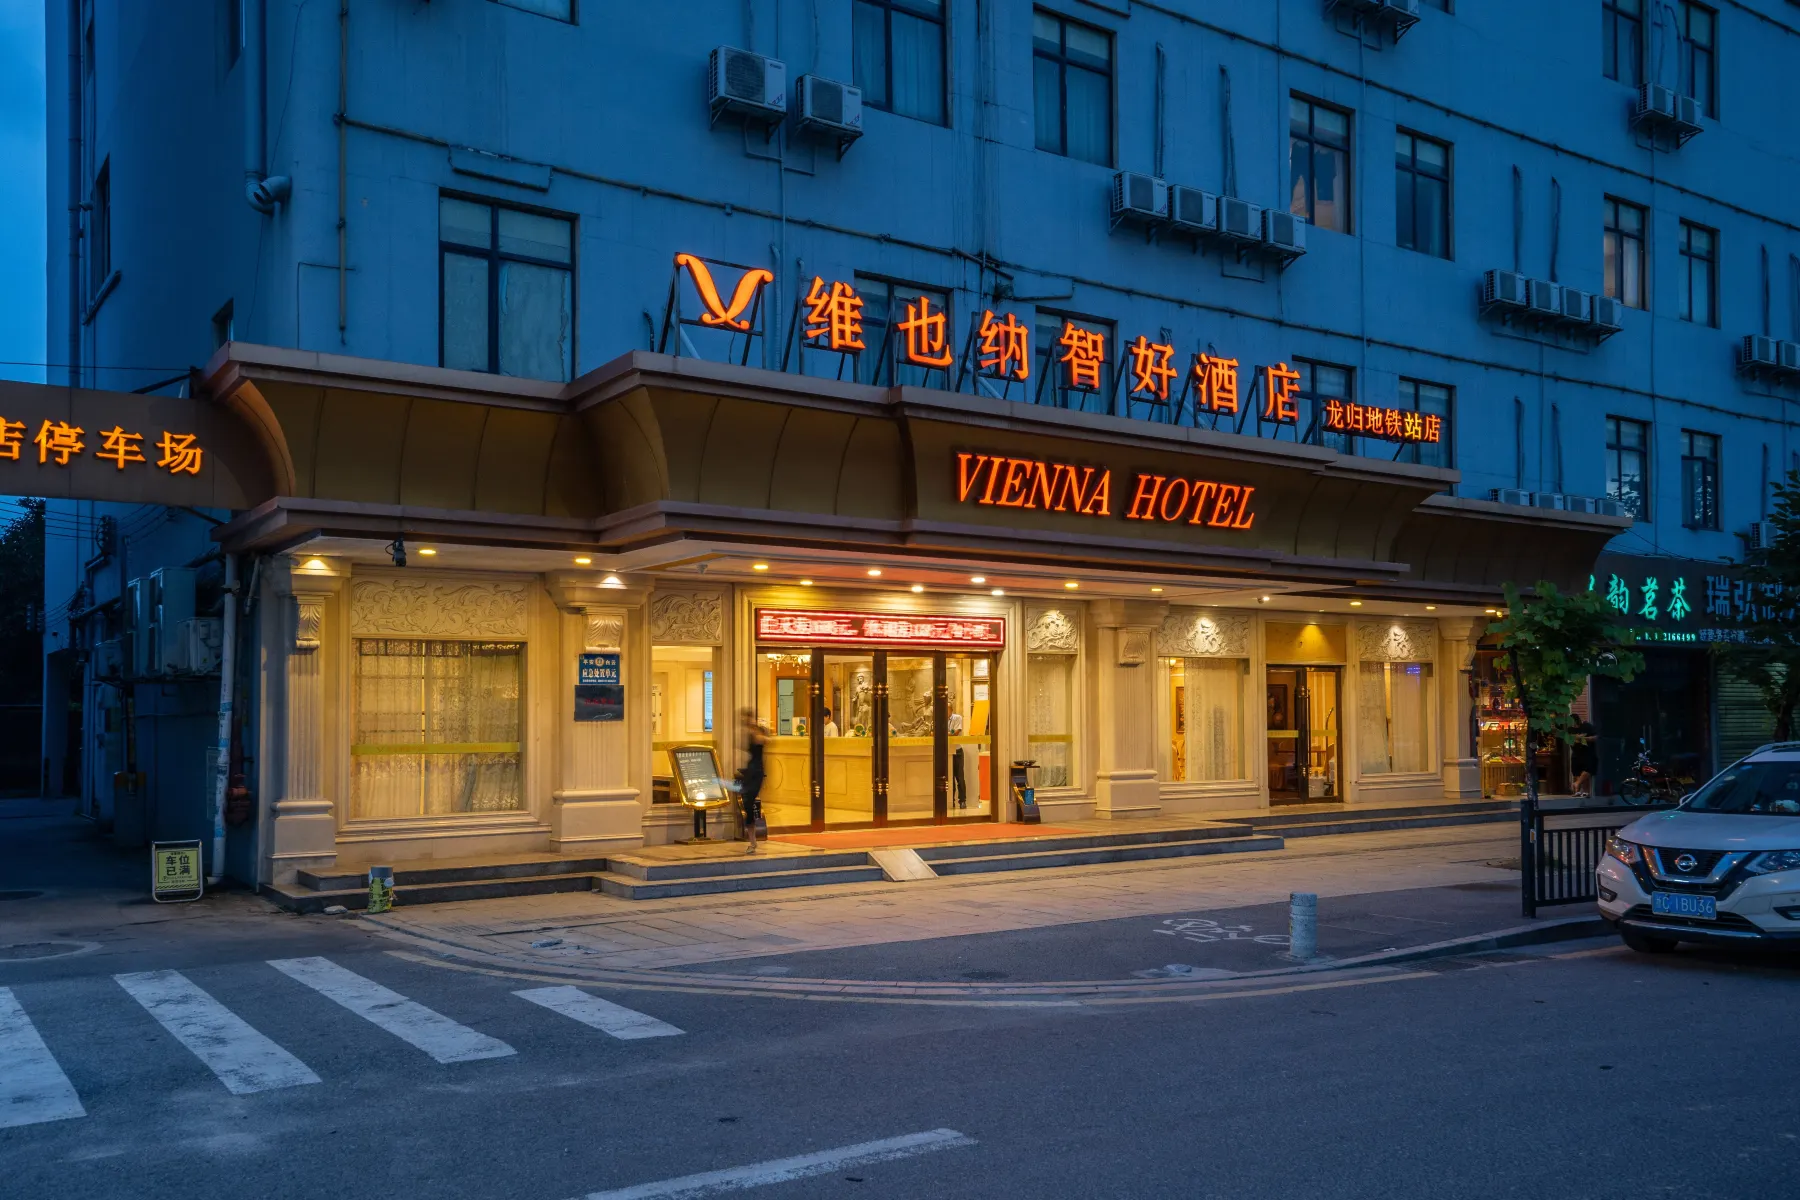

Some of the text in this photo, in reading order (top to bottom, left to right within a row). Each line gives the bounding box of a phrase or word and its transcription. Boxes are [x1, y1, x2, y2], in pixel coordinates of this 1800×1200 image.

[805, 275, 1302, 421] 维也纳智好酒店
[1326, 399, 1441, 443] 龙归地铁站店
[957, 453, 1256, 529] VIENNA HOTEL
[1588, 573, 1693, 622] 韵茗茶
